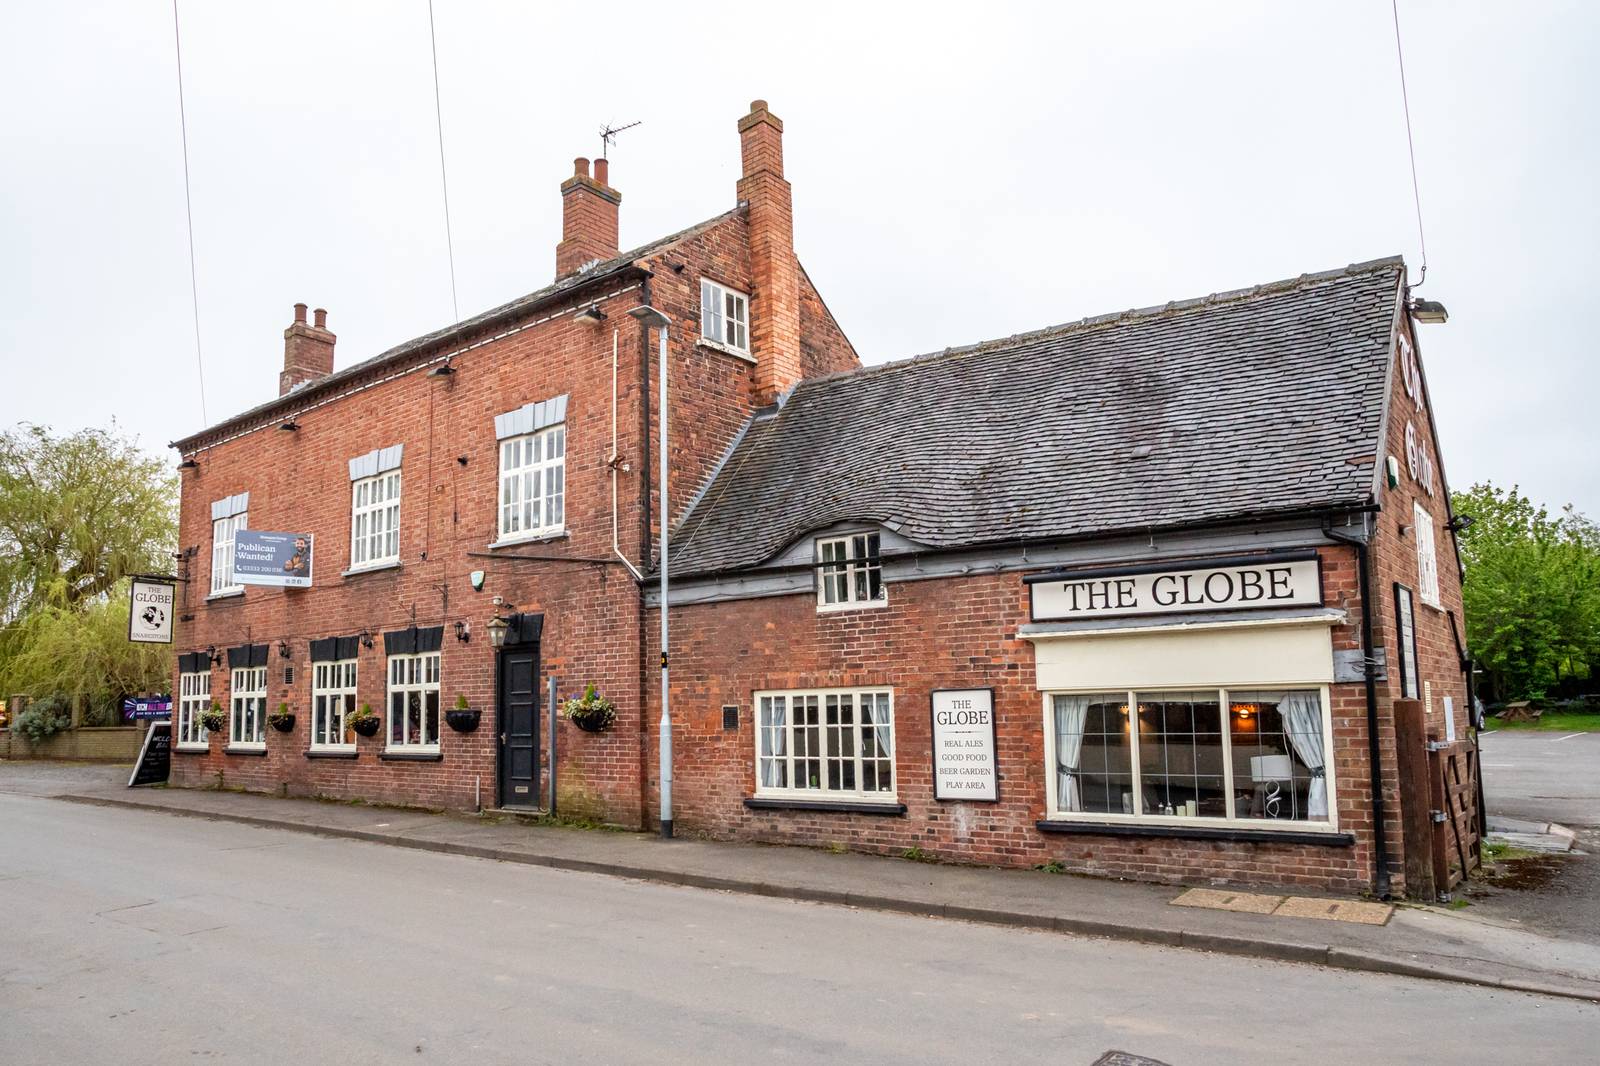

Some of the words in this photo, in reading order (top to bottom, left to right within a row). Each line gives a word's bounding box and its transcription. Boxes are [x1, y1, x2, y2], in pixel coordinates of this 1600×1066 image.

[237, 543, 276, 553] Publican
[237, 552, 273, 561] Wanted!
[1064, 579, 1138, 612] THE
[1152, 568, 1294, 606] GLOBE
[135, 592, 171, 604] GLOBE
[952, 700, 971, 709] THE
[937, 710, 988, 725] GLOBE
[944, 740, 963, 748] REAL
[942, 753, 964, 761] GOOD
[966, 753, 987, 761] FOOD
[939, 767, 958, 775] BEER
[960, 767, 991, 775] GARDEN
[946, 781, 963, 789] PLAY
[965, 781, 985, 789] AREA
